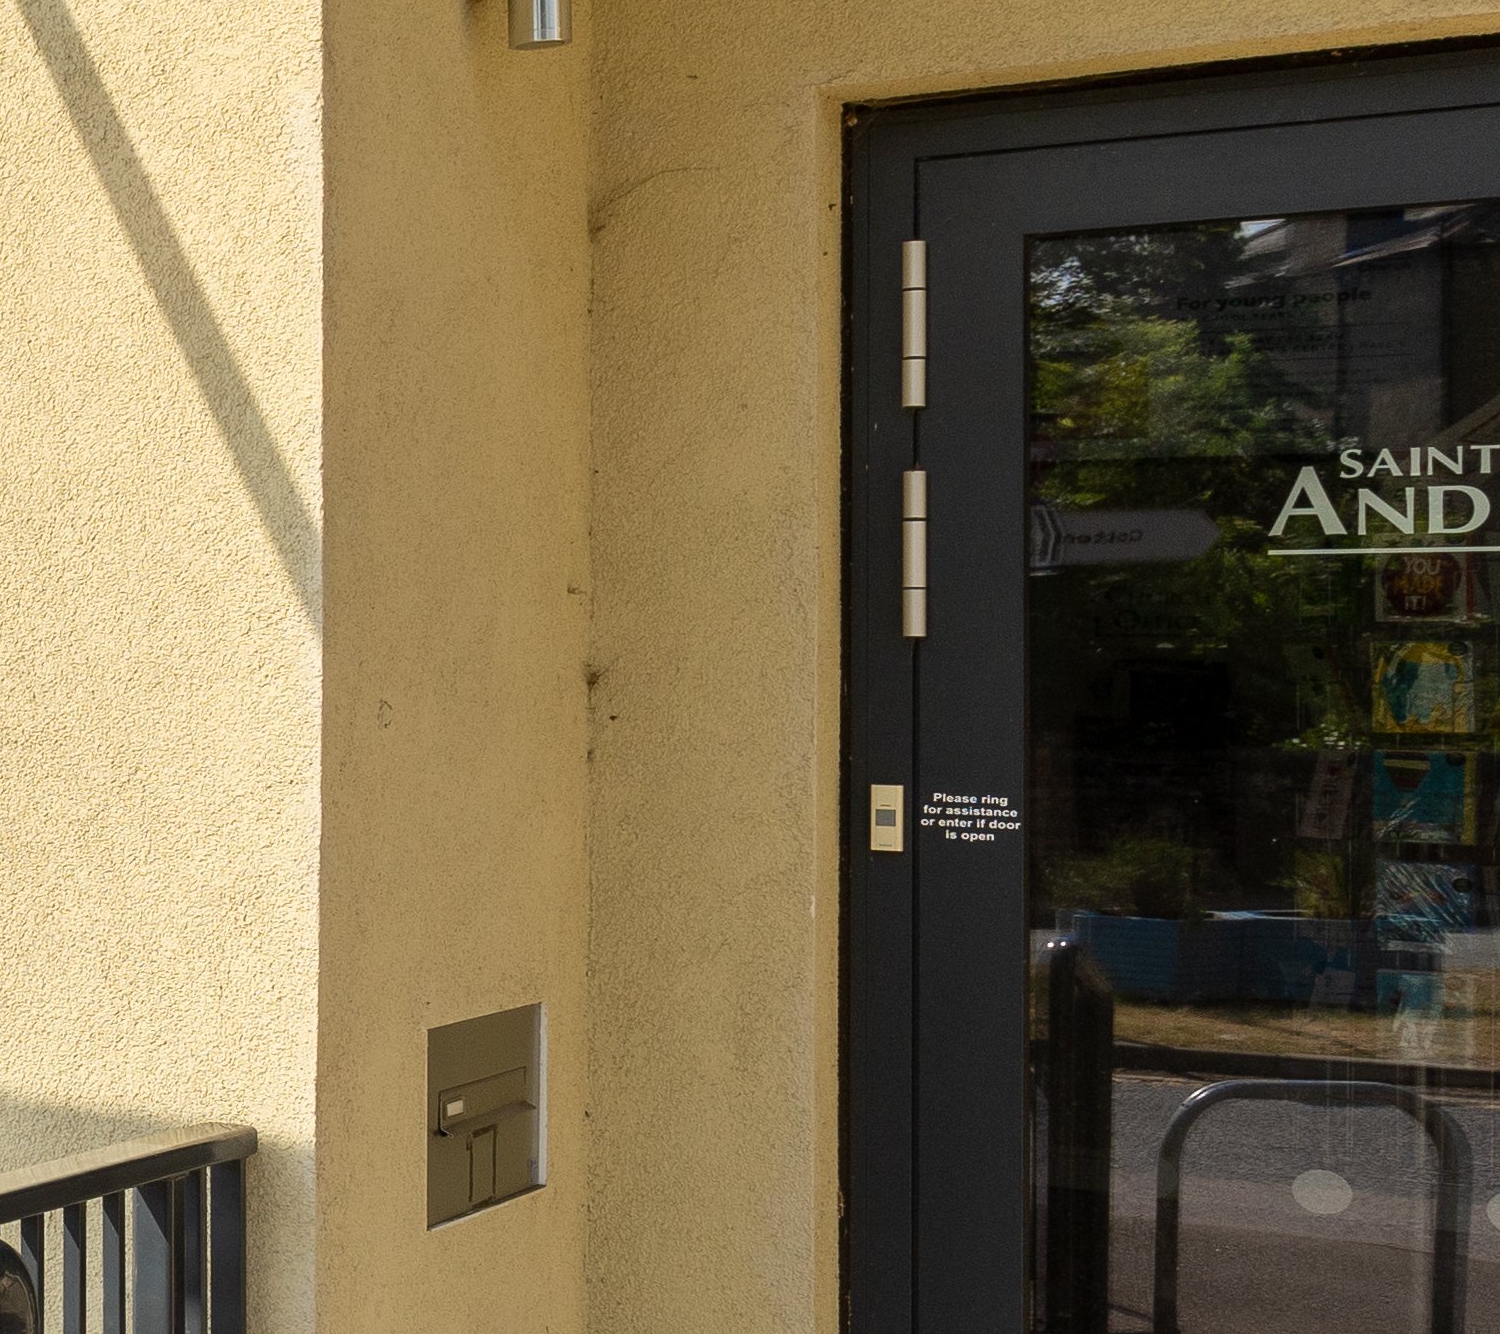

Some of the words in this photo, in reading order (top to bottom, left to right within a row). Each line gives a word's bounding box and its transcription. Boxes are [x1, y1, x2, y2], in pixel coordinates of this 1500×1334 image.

[1215, 293, 1286, 311] young
[1339, 444, 1500, 479] SAINT
[932, 792, 978, 804] Please
[981, 794, 1009, 807] ring
[923, 804, 943, 815] for
[945, 806, 1018, 818] assistance
[920, 818, 936, 826] or
[938, 817, 973, 828] enter
[988, 819, 1022, 830] door
[960, 832, 995, 842] open
